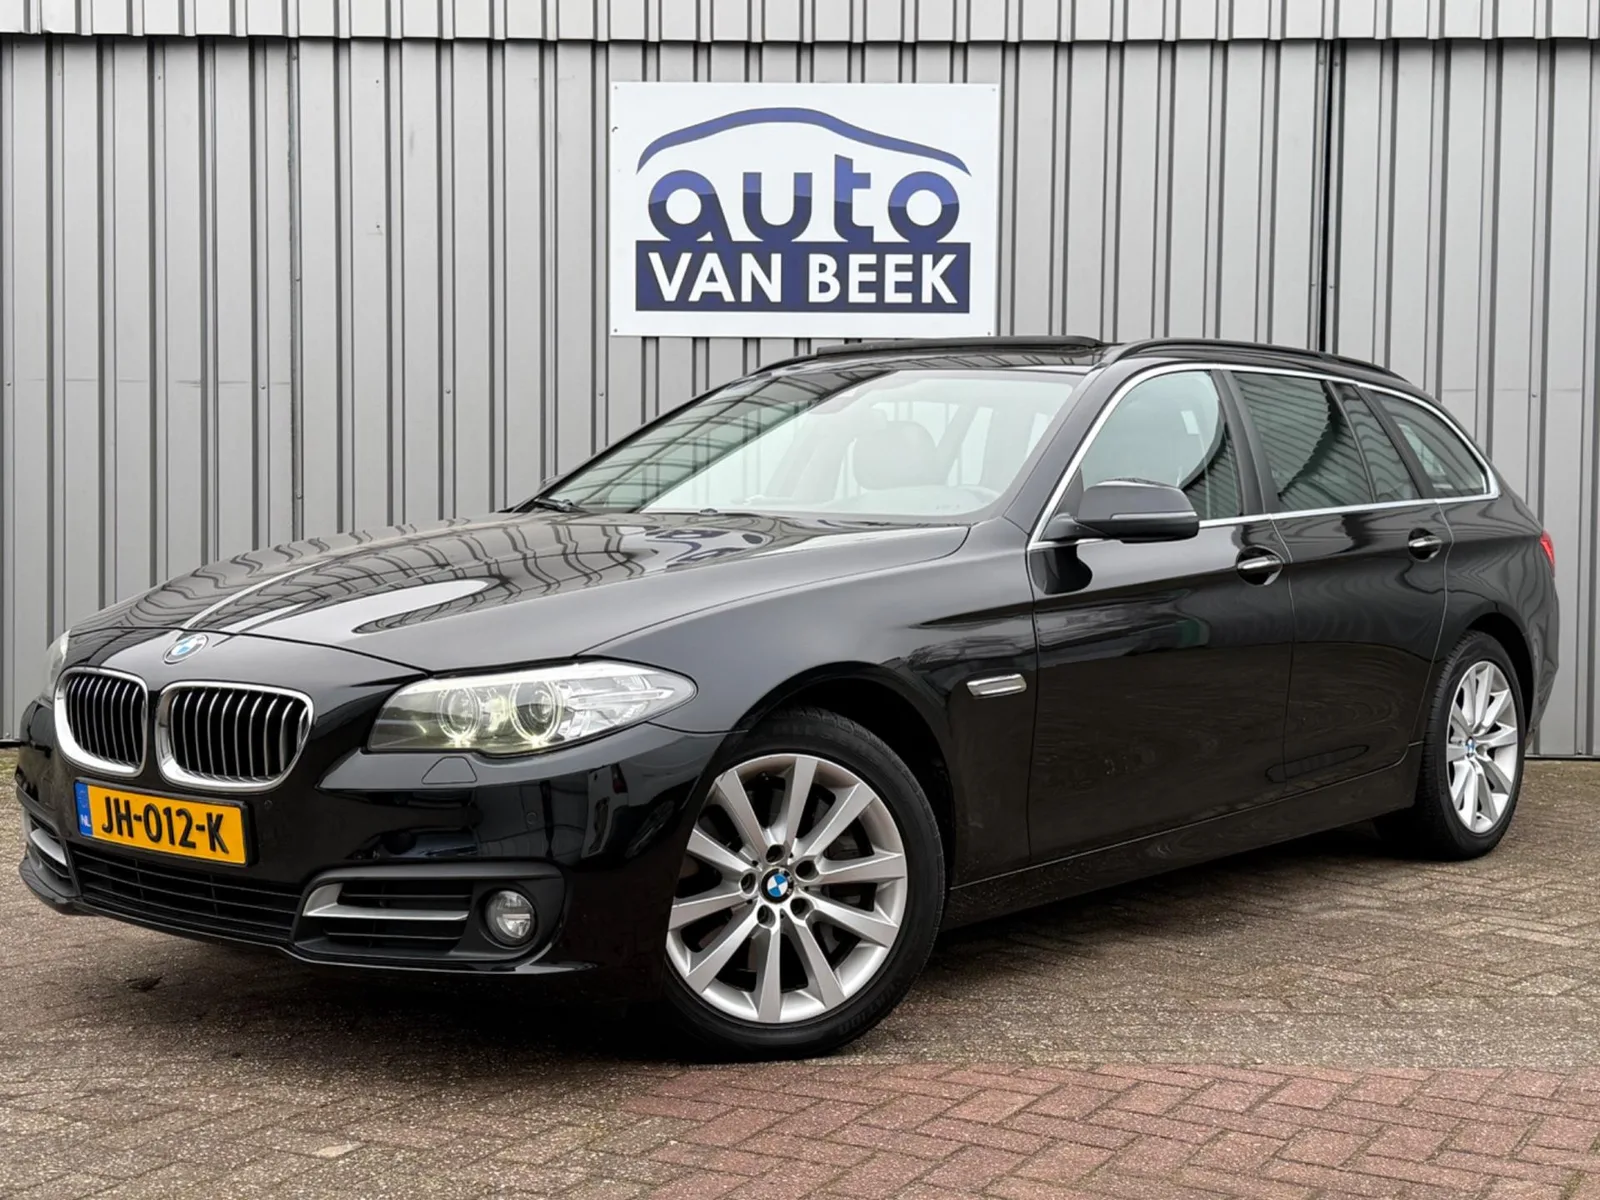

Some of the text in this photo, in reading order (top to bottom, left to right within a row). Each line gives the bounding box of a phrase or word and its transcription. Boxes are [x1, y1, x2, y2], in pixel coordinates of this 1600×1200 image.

[648, 154, 960, 242] auto
[648, 252, 958, 304] VAN BEEK
[80, 814, 91, 827] NL
[102, 796, 230, 854] JH-012-K
